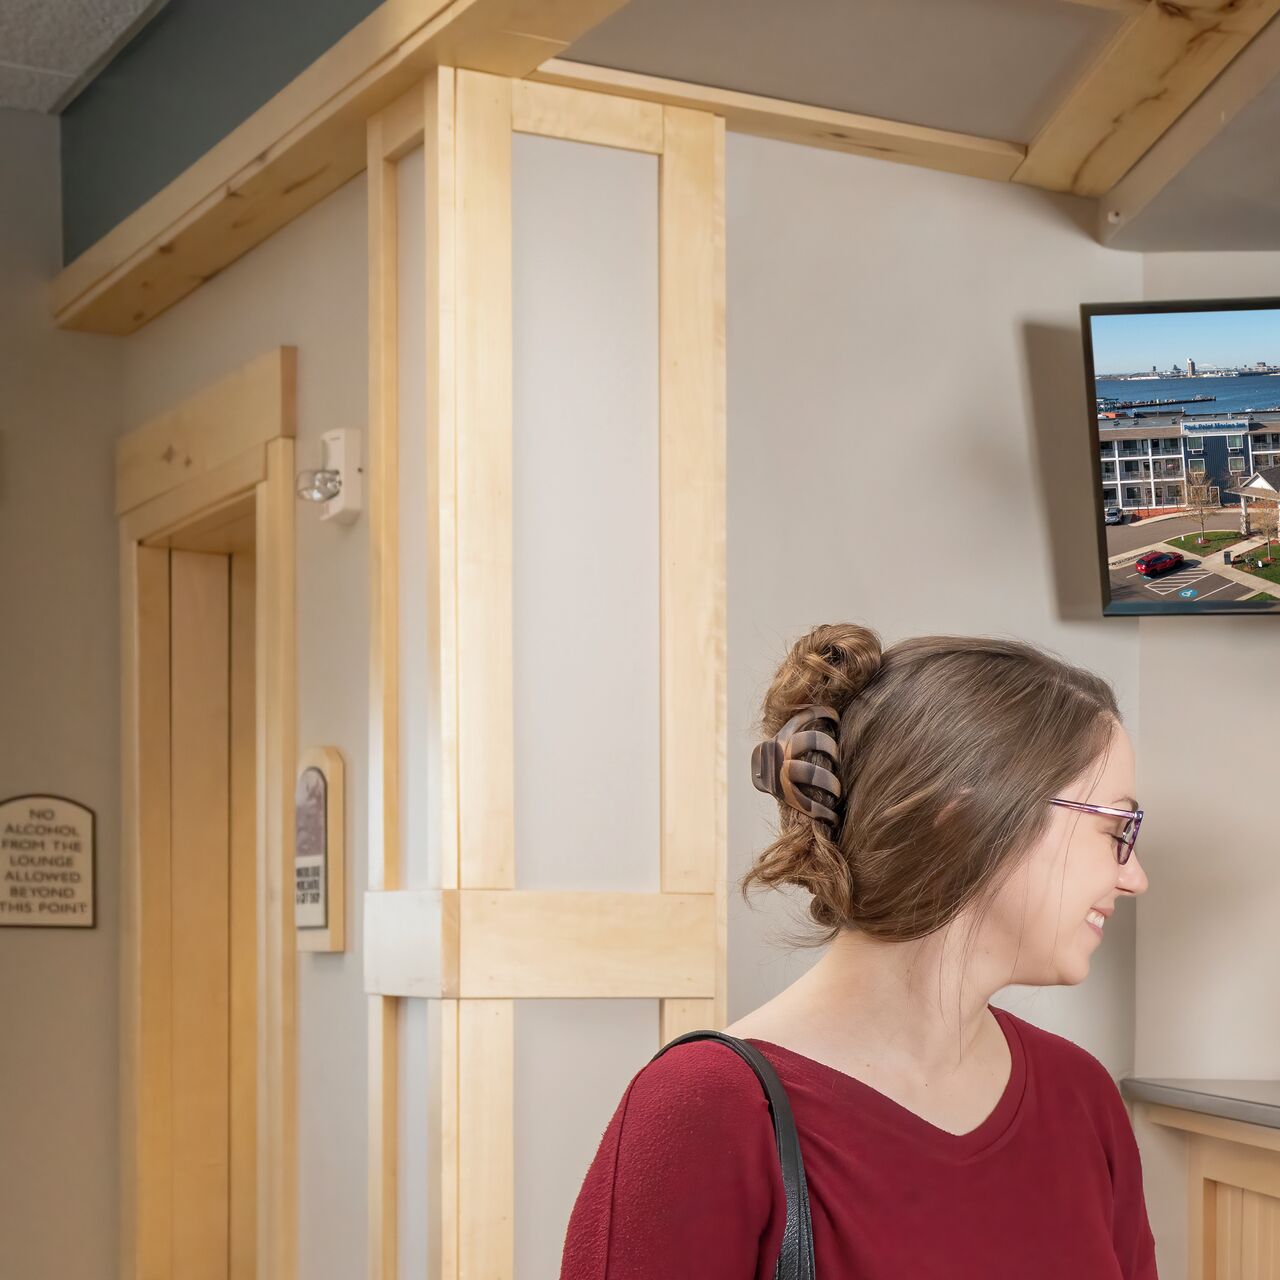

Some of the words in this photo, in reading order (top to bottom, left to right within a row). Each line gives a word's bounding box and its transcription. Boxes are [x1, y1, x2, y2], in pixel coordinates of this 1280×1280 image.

[29, 808, 55, 821] NO
[4, 824, 79, 837] ALCOHOL
[2, 839, 45, 851] FROM
[53, 840, 82, 853] THE
[10, 855, 74, 868] LOUNGE
[5, 870, 82, 883] ALLOWED
[10, 886, 75, 898] BEYOND
[0, 901, 32, 913] THIS
[39, 901, 87, 914] POINT
